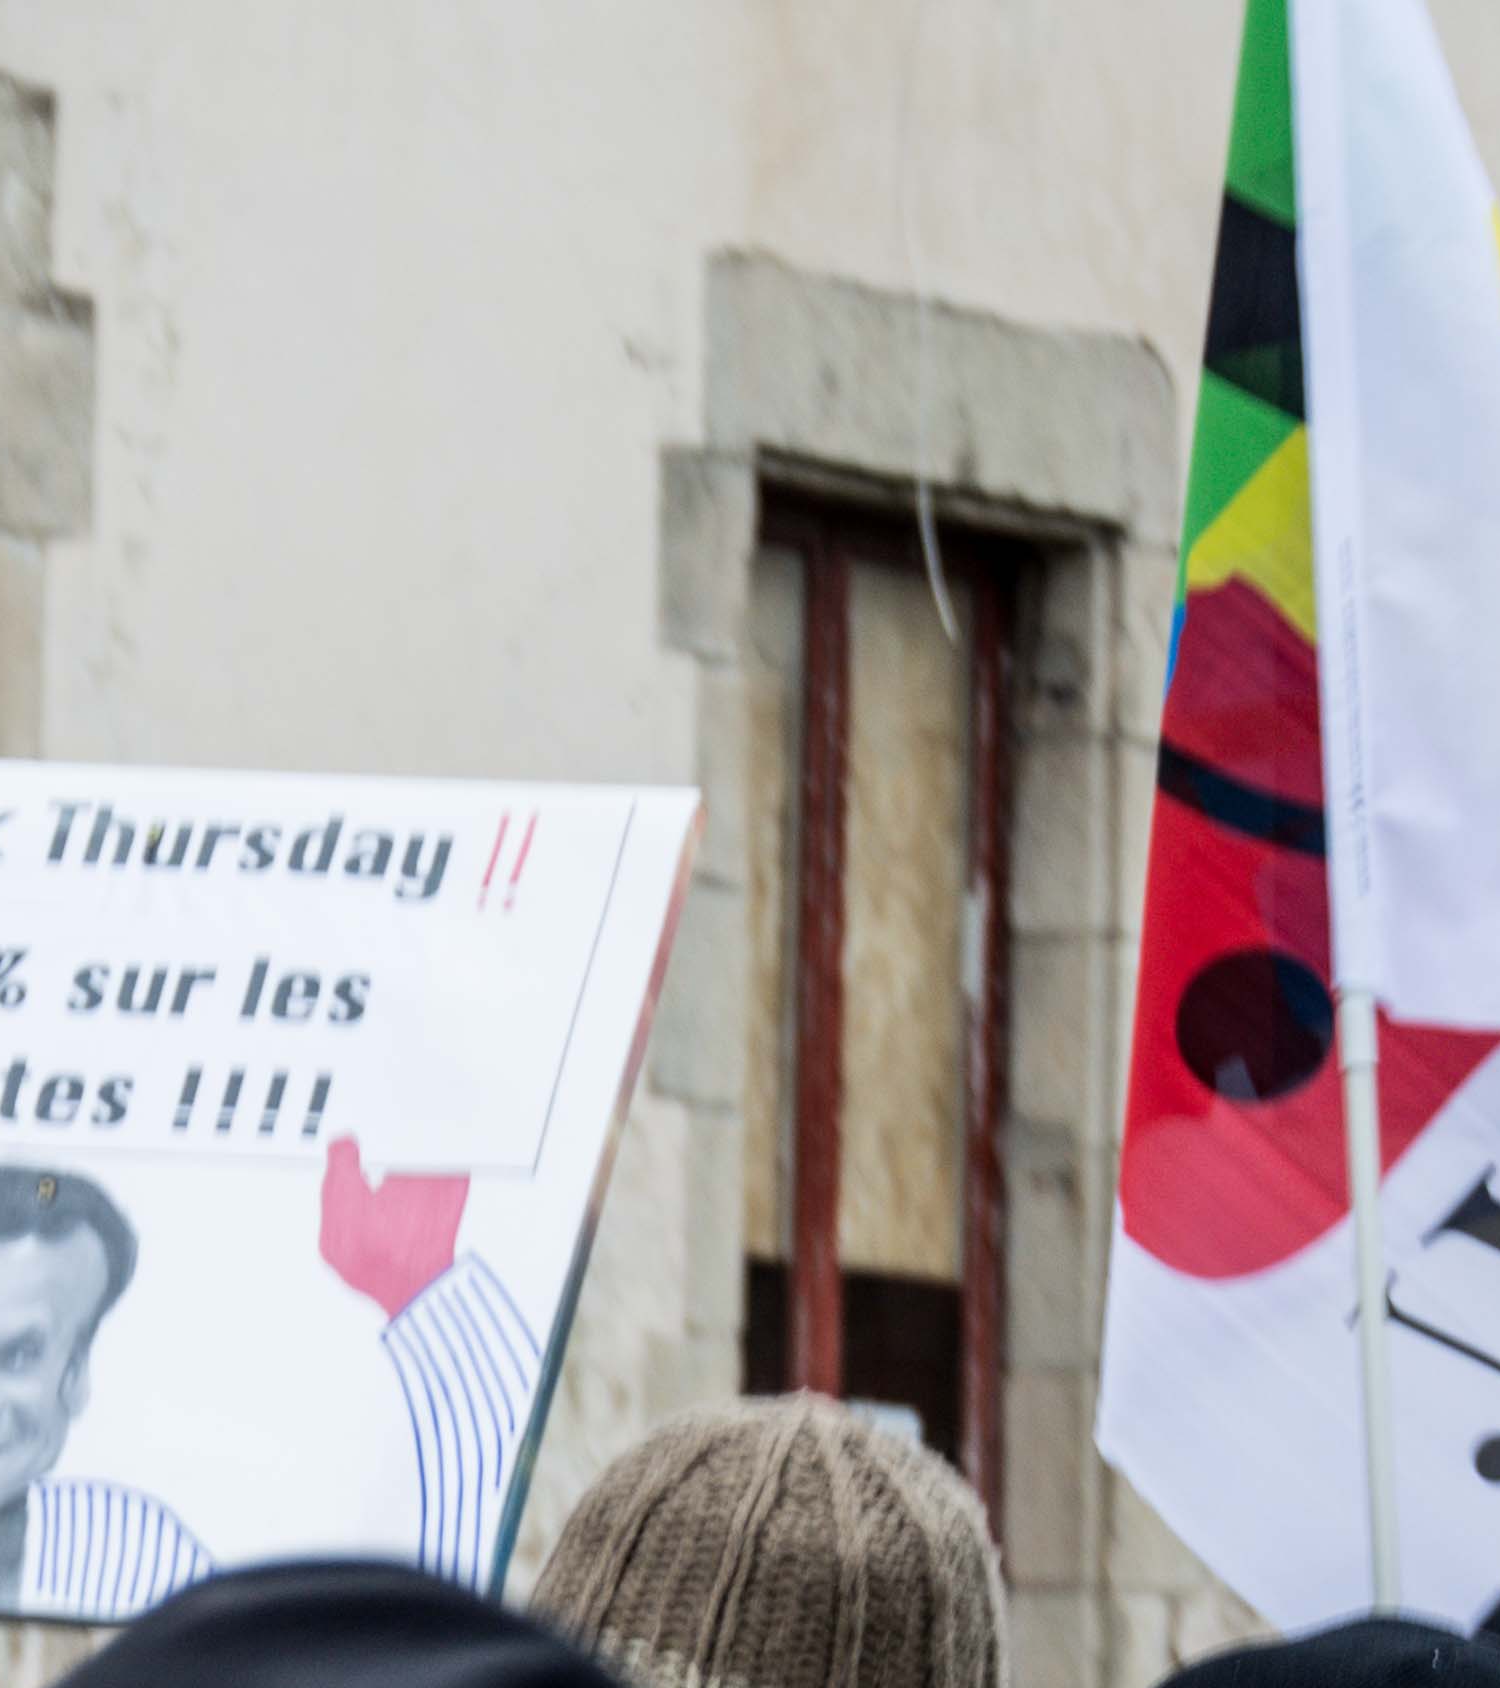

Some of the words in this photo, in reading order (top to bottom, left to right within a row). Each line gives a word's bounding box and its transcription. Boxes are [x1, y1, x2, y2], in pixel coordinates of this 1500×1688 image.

[44, 800, 453, 904] Thursday
[66, 961, 215, 1022] sur
[239, 956, 372, 1025] les
